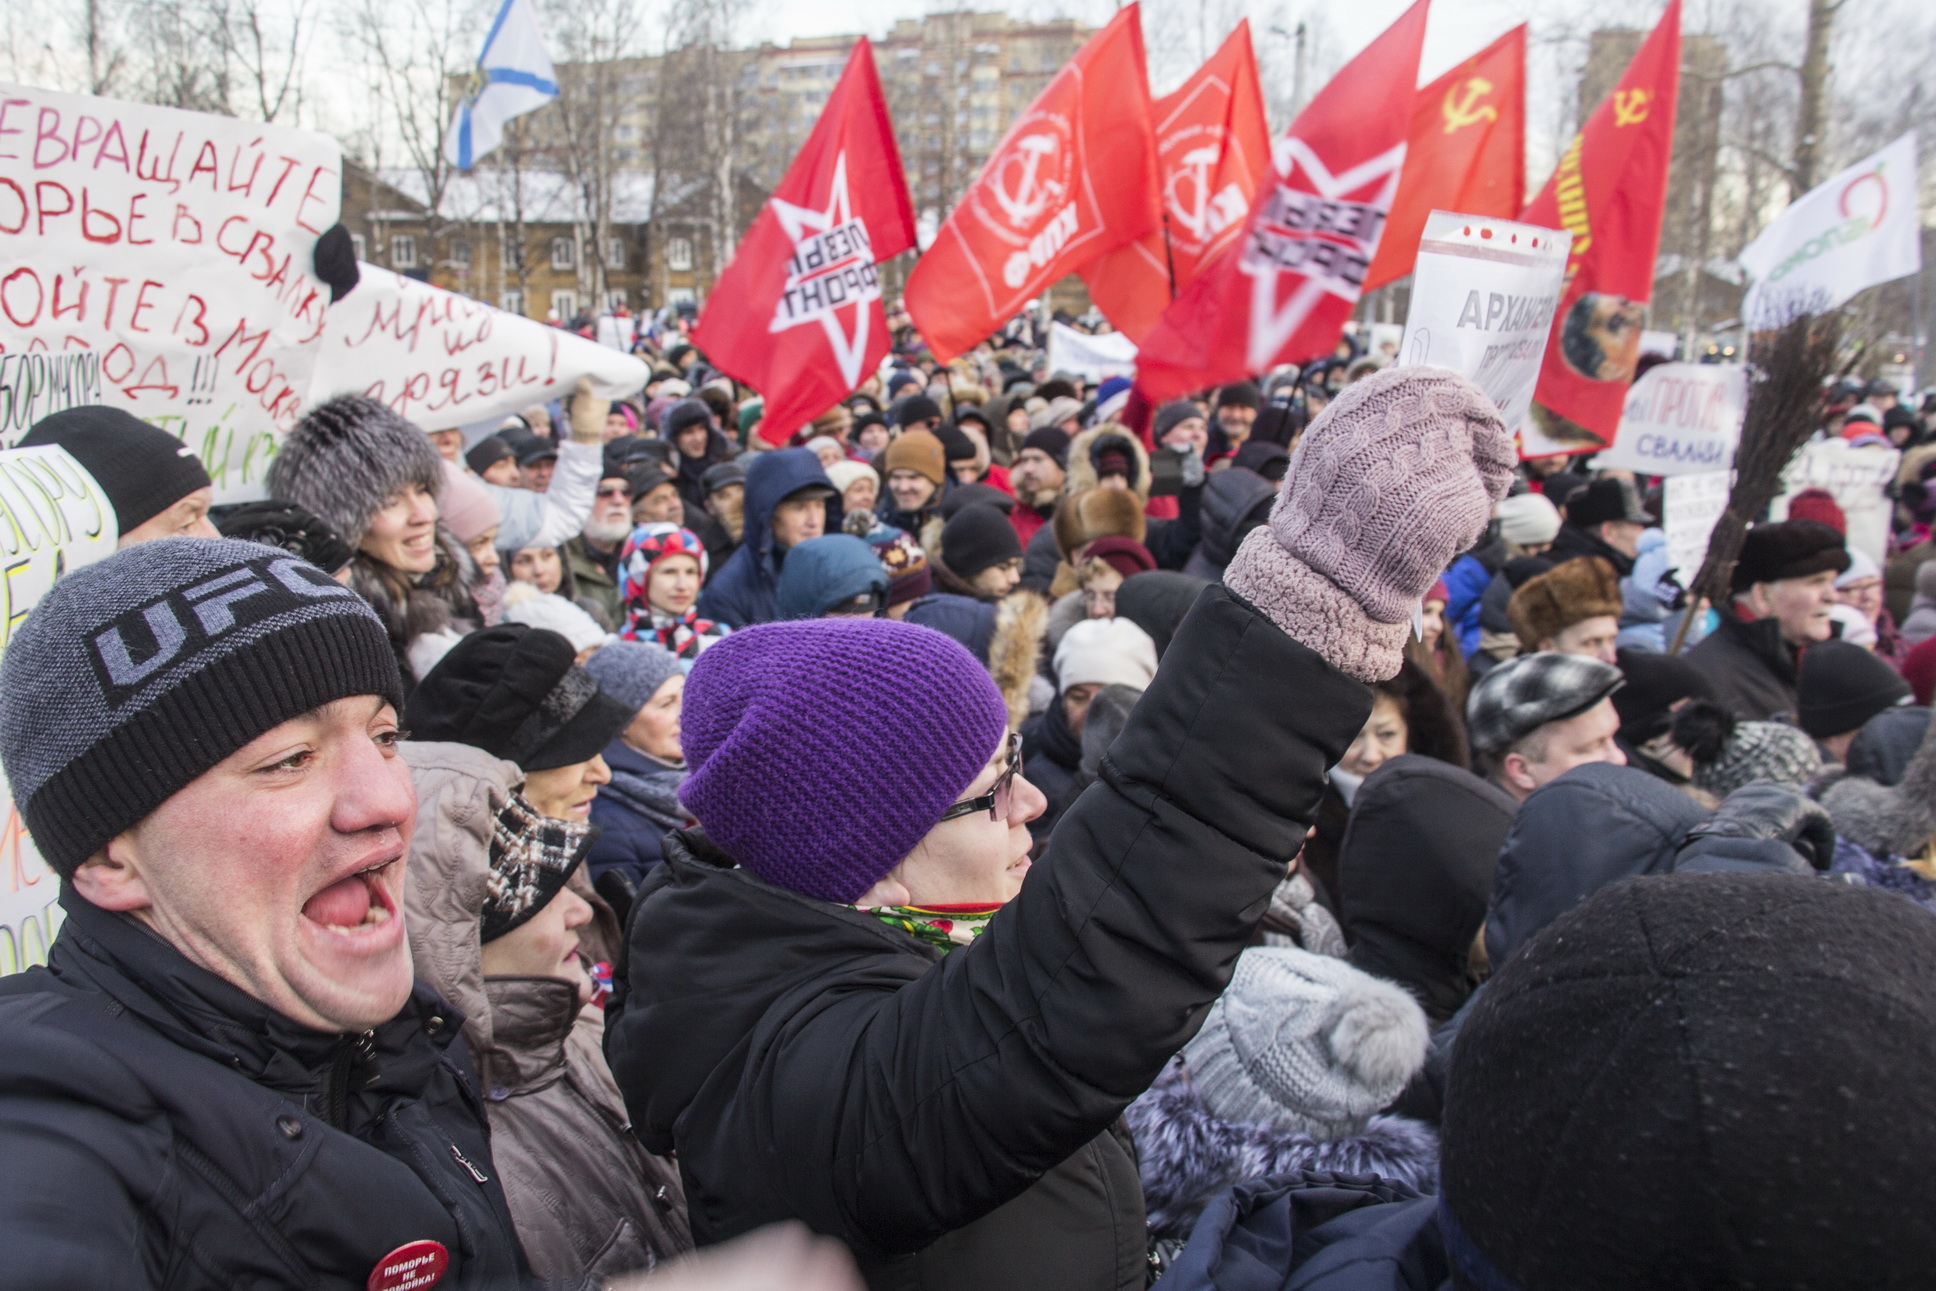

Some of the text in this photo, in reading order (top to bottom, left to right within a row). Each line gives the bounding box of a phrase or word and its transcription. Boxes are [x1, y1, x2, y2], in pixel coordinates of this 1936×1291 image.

[172, 203, 203, 244] В
[217, 215, 327, 344] СВАЛКУ
[173, 293, 209, 346] В
[95, 558, 351, 685] UFC
[381, 1272, 435, 1291] ОМОЙКА!
[383, 1252, 435, 1279] ПОМОРЬЕ
[403, 1270, 416, 1282] НЕ
